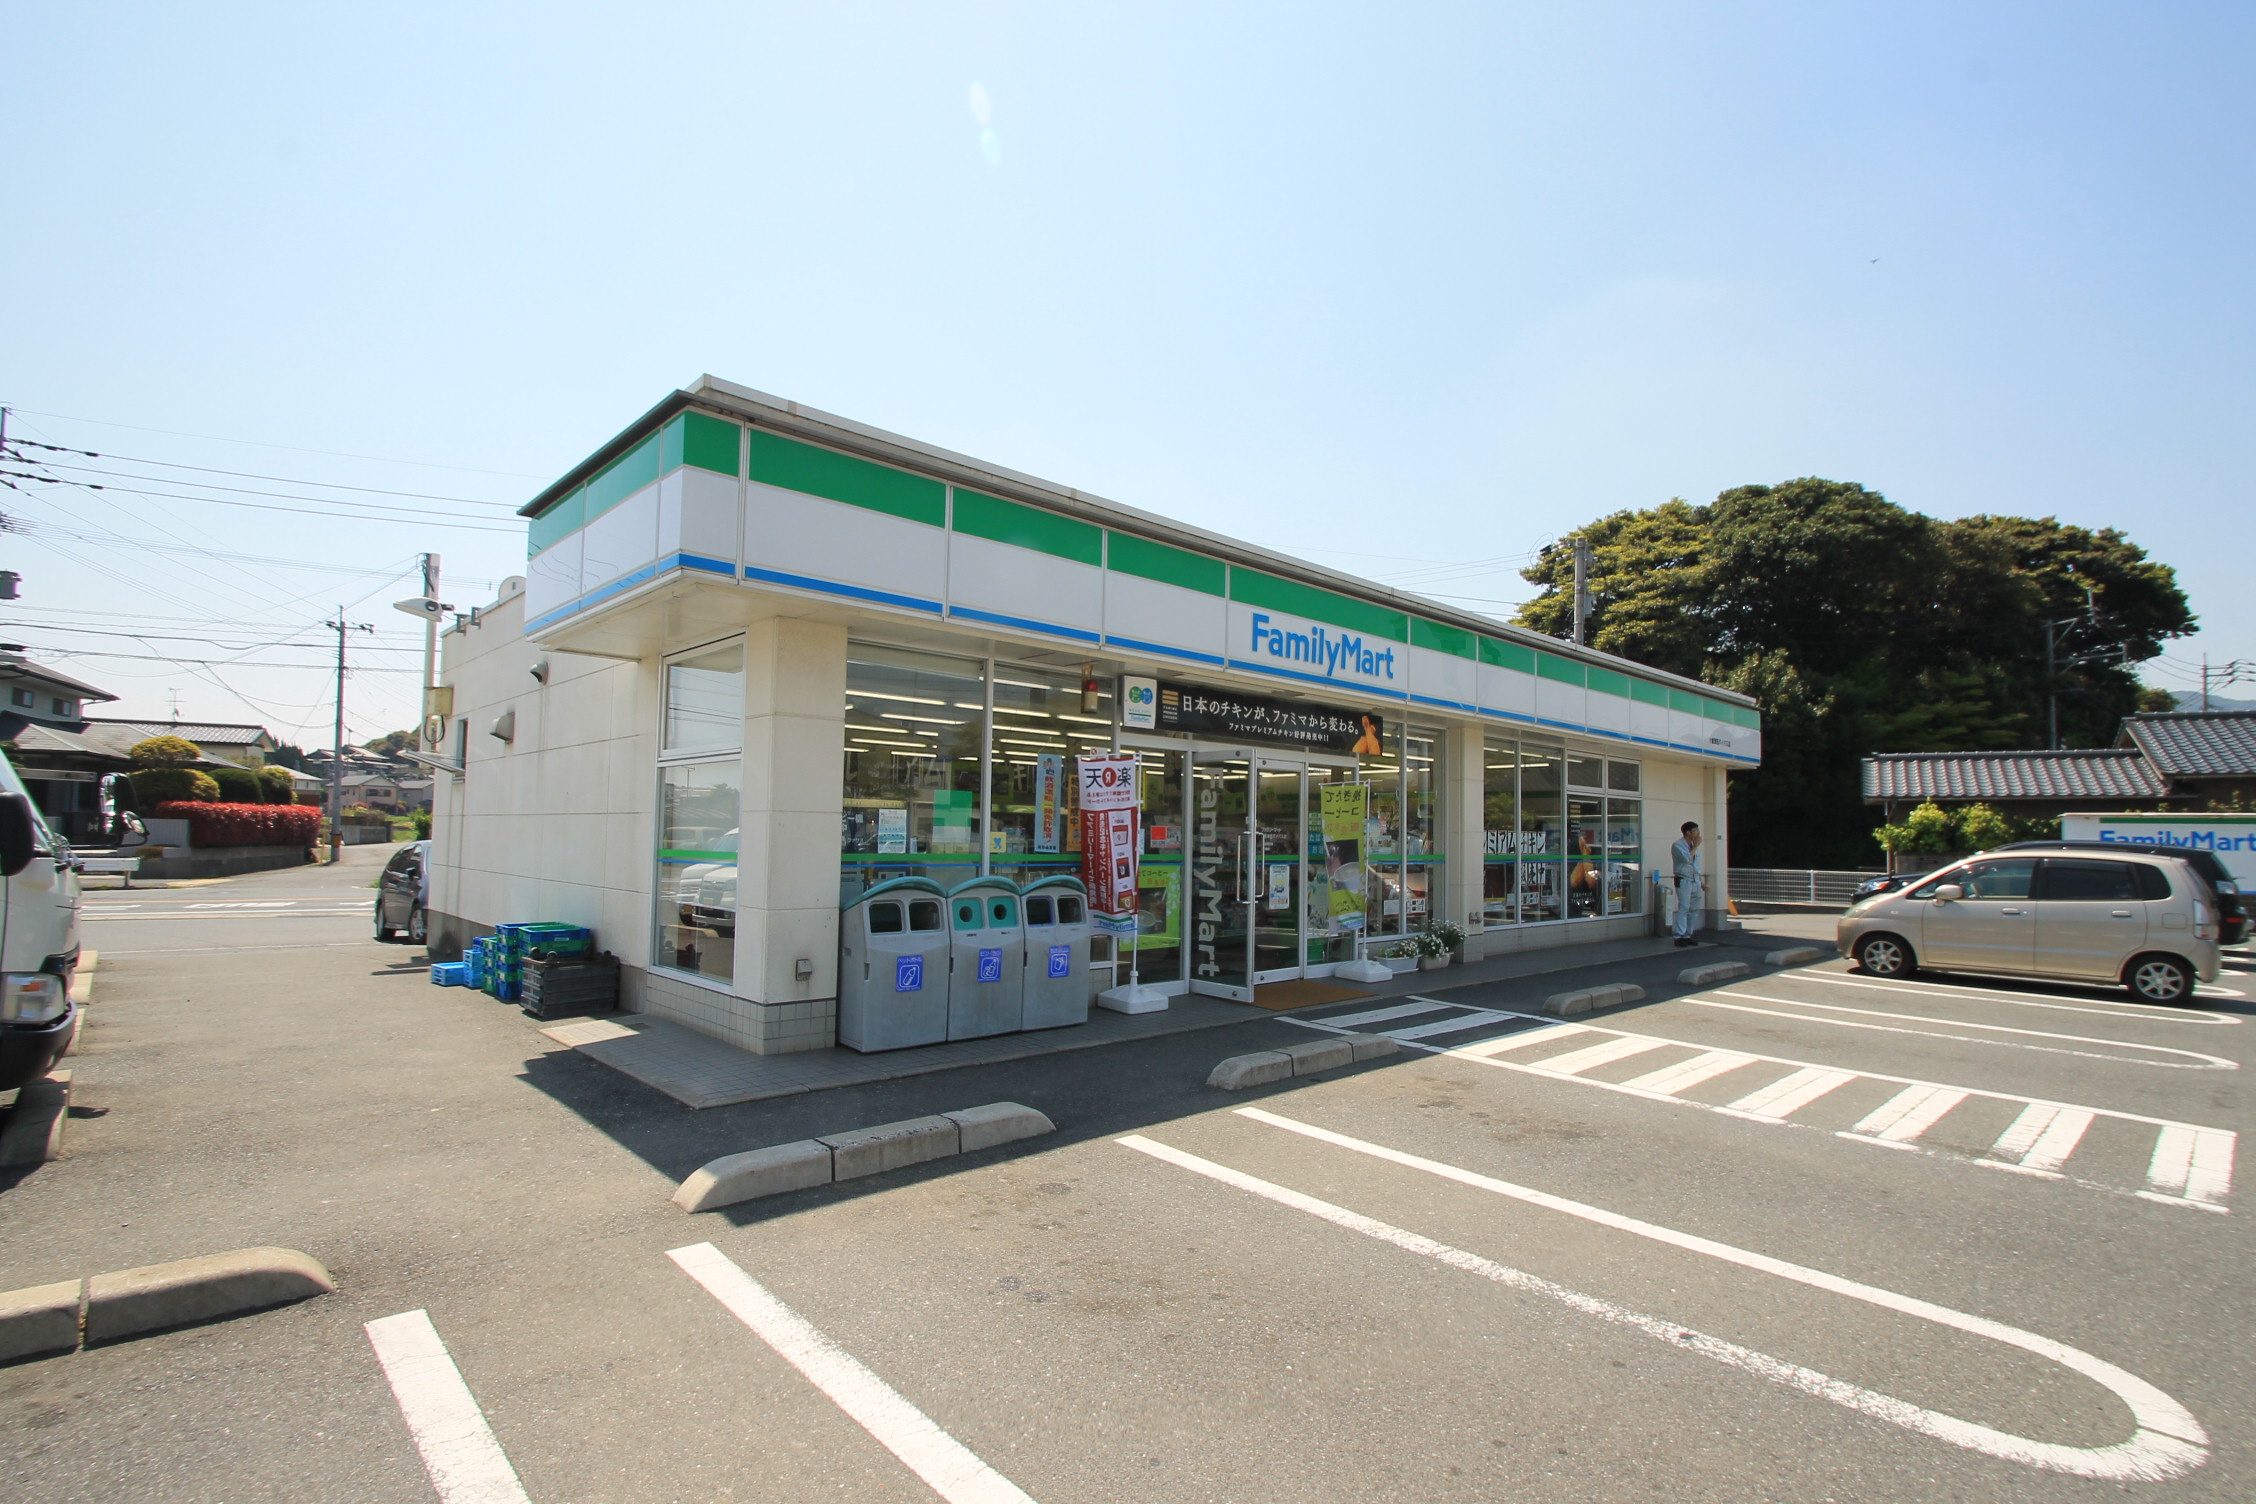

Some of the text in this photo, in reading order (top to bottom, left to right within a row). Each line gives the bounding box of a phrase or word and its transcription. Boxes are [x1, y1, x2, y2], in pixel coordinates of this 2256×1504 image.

[1252, 612, 1394, 679] FamilyMart
[1183, 695, 1360, 735] 日本のチキンが、ファミマから変わる。
[1483, 831, 1546, 854] ミアムチキン
[1193, 767, 1224, 977] FamilyMart
